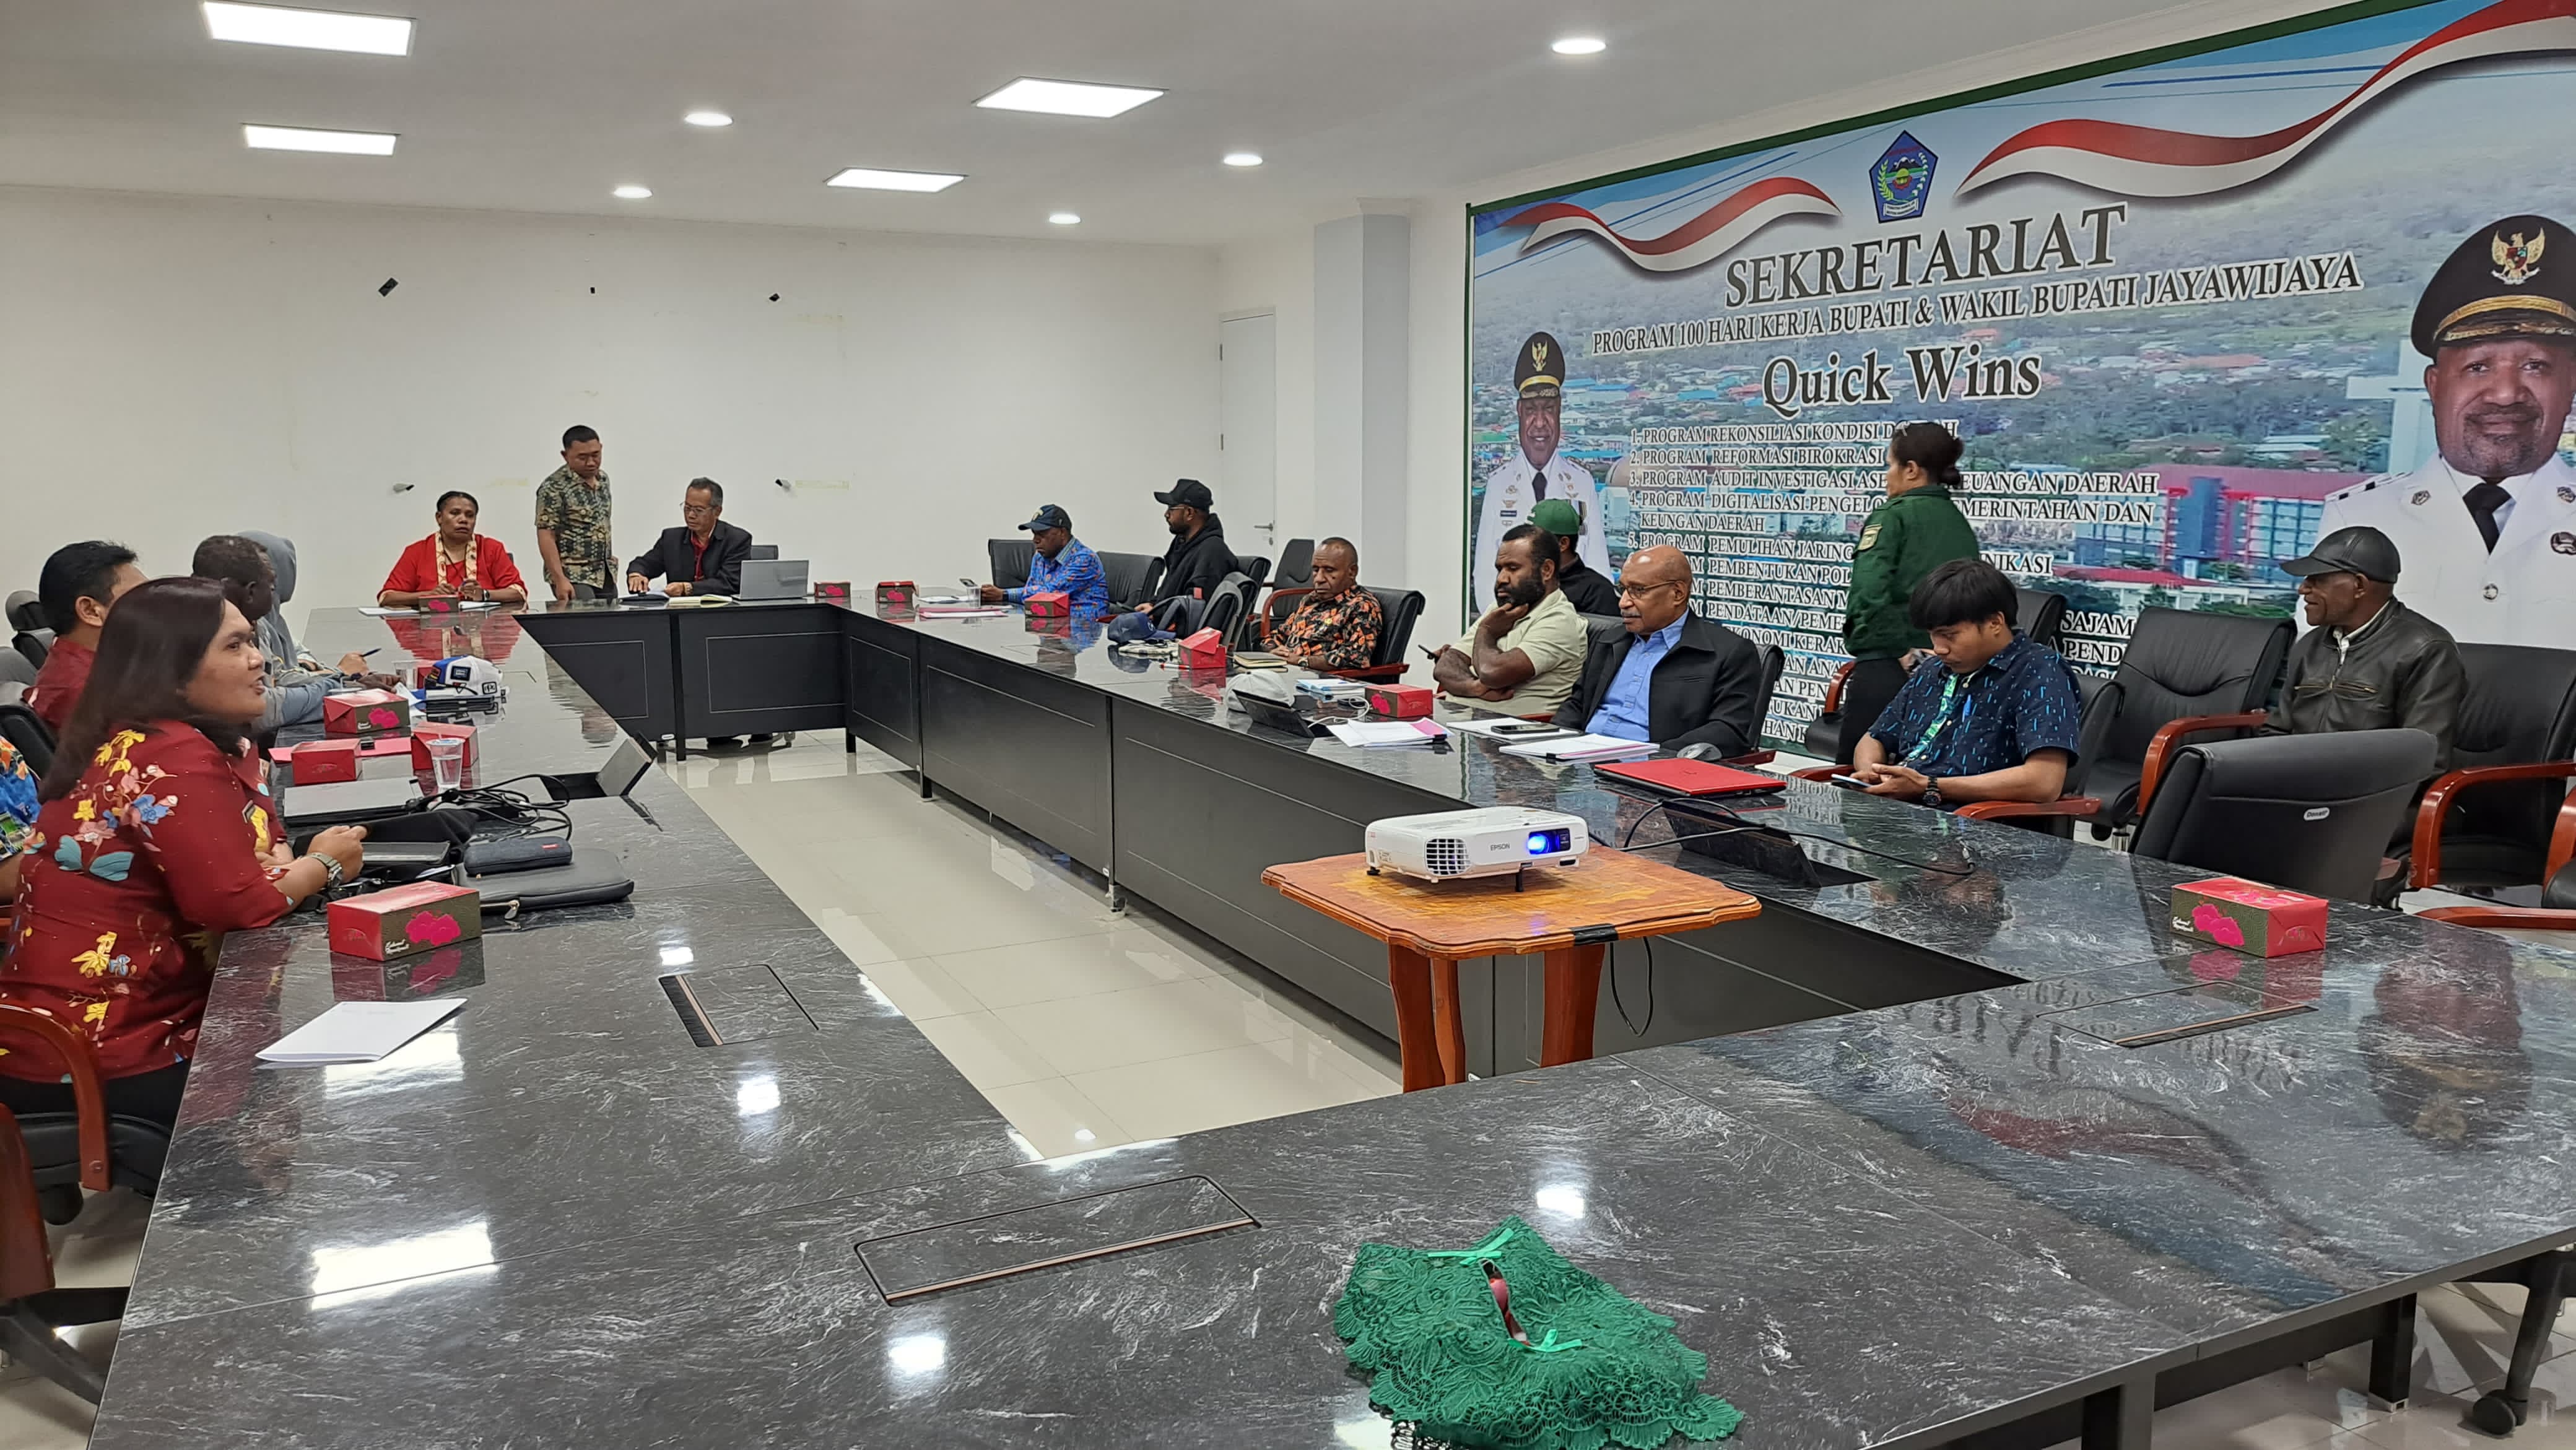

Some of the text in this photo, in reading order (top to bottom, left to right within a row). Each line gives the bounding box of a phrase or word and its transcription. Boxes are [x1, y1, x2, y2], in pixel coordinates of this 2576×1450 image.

[1727, 205, 2126, 306] SEKRETARIAT
[1593, 256, 2361, 354] PROGRAM 100 HARI KERJA BUPATI & WAKIL BUPATI JAYAWIJAYA
[1764, 342, 2040, 417] Quick Wins
[1632, 430, 1640, 443] 1.
[1643, 427, 1707, 443] PROGRAM
[1710, 424, 1808, 442] REKONSILIASI
[1813, 422, 1878, 440] KONDISI
[1630, 448, 1882, 464] 2. PROGRAM REFORMASI BIROKRASI
[1630, 471, 2157, 494] 3. PROGRAM AUDIT INVESTIGASI ASE EUANGAN DAERAH
[1629, 492, 1638, 506] 4.
[1642, 492, 1705, 508] PROGRAM
[1712, 494, 1805, 511] DIGITALISASI
[1811, 496, 1887, 513] PENGELO
[2104, 503, 2154, 523] DAN
[1641, 513, 1765, 532] KEUNGAN DAERAH
[1627, 532, 2052, 574] 5. PROGRAM PEMULIHAN JARING NIKASI
[1708, 558, 1818, 582] PEMBENTUKAN
[1821, 567, 1852, 586] POL
[1708, 581, 1835, 608] PEMBERANTASAN
[2061, 612, 2134, 637] SAJAM
[1707, 601, 1843, 631] PENDATAAN/PEME
[2063, 640, 2123, 664] PEND
[1728, 627, 1848, 655] KONOMI KERAK
[1798, 680, 1827, 700] PEN
[1772, 699, 1816, 720] UKAN
[1765, 720, 1796, 742] HAN
[1490, 843, 1510, 851] EPSON
